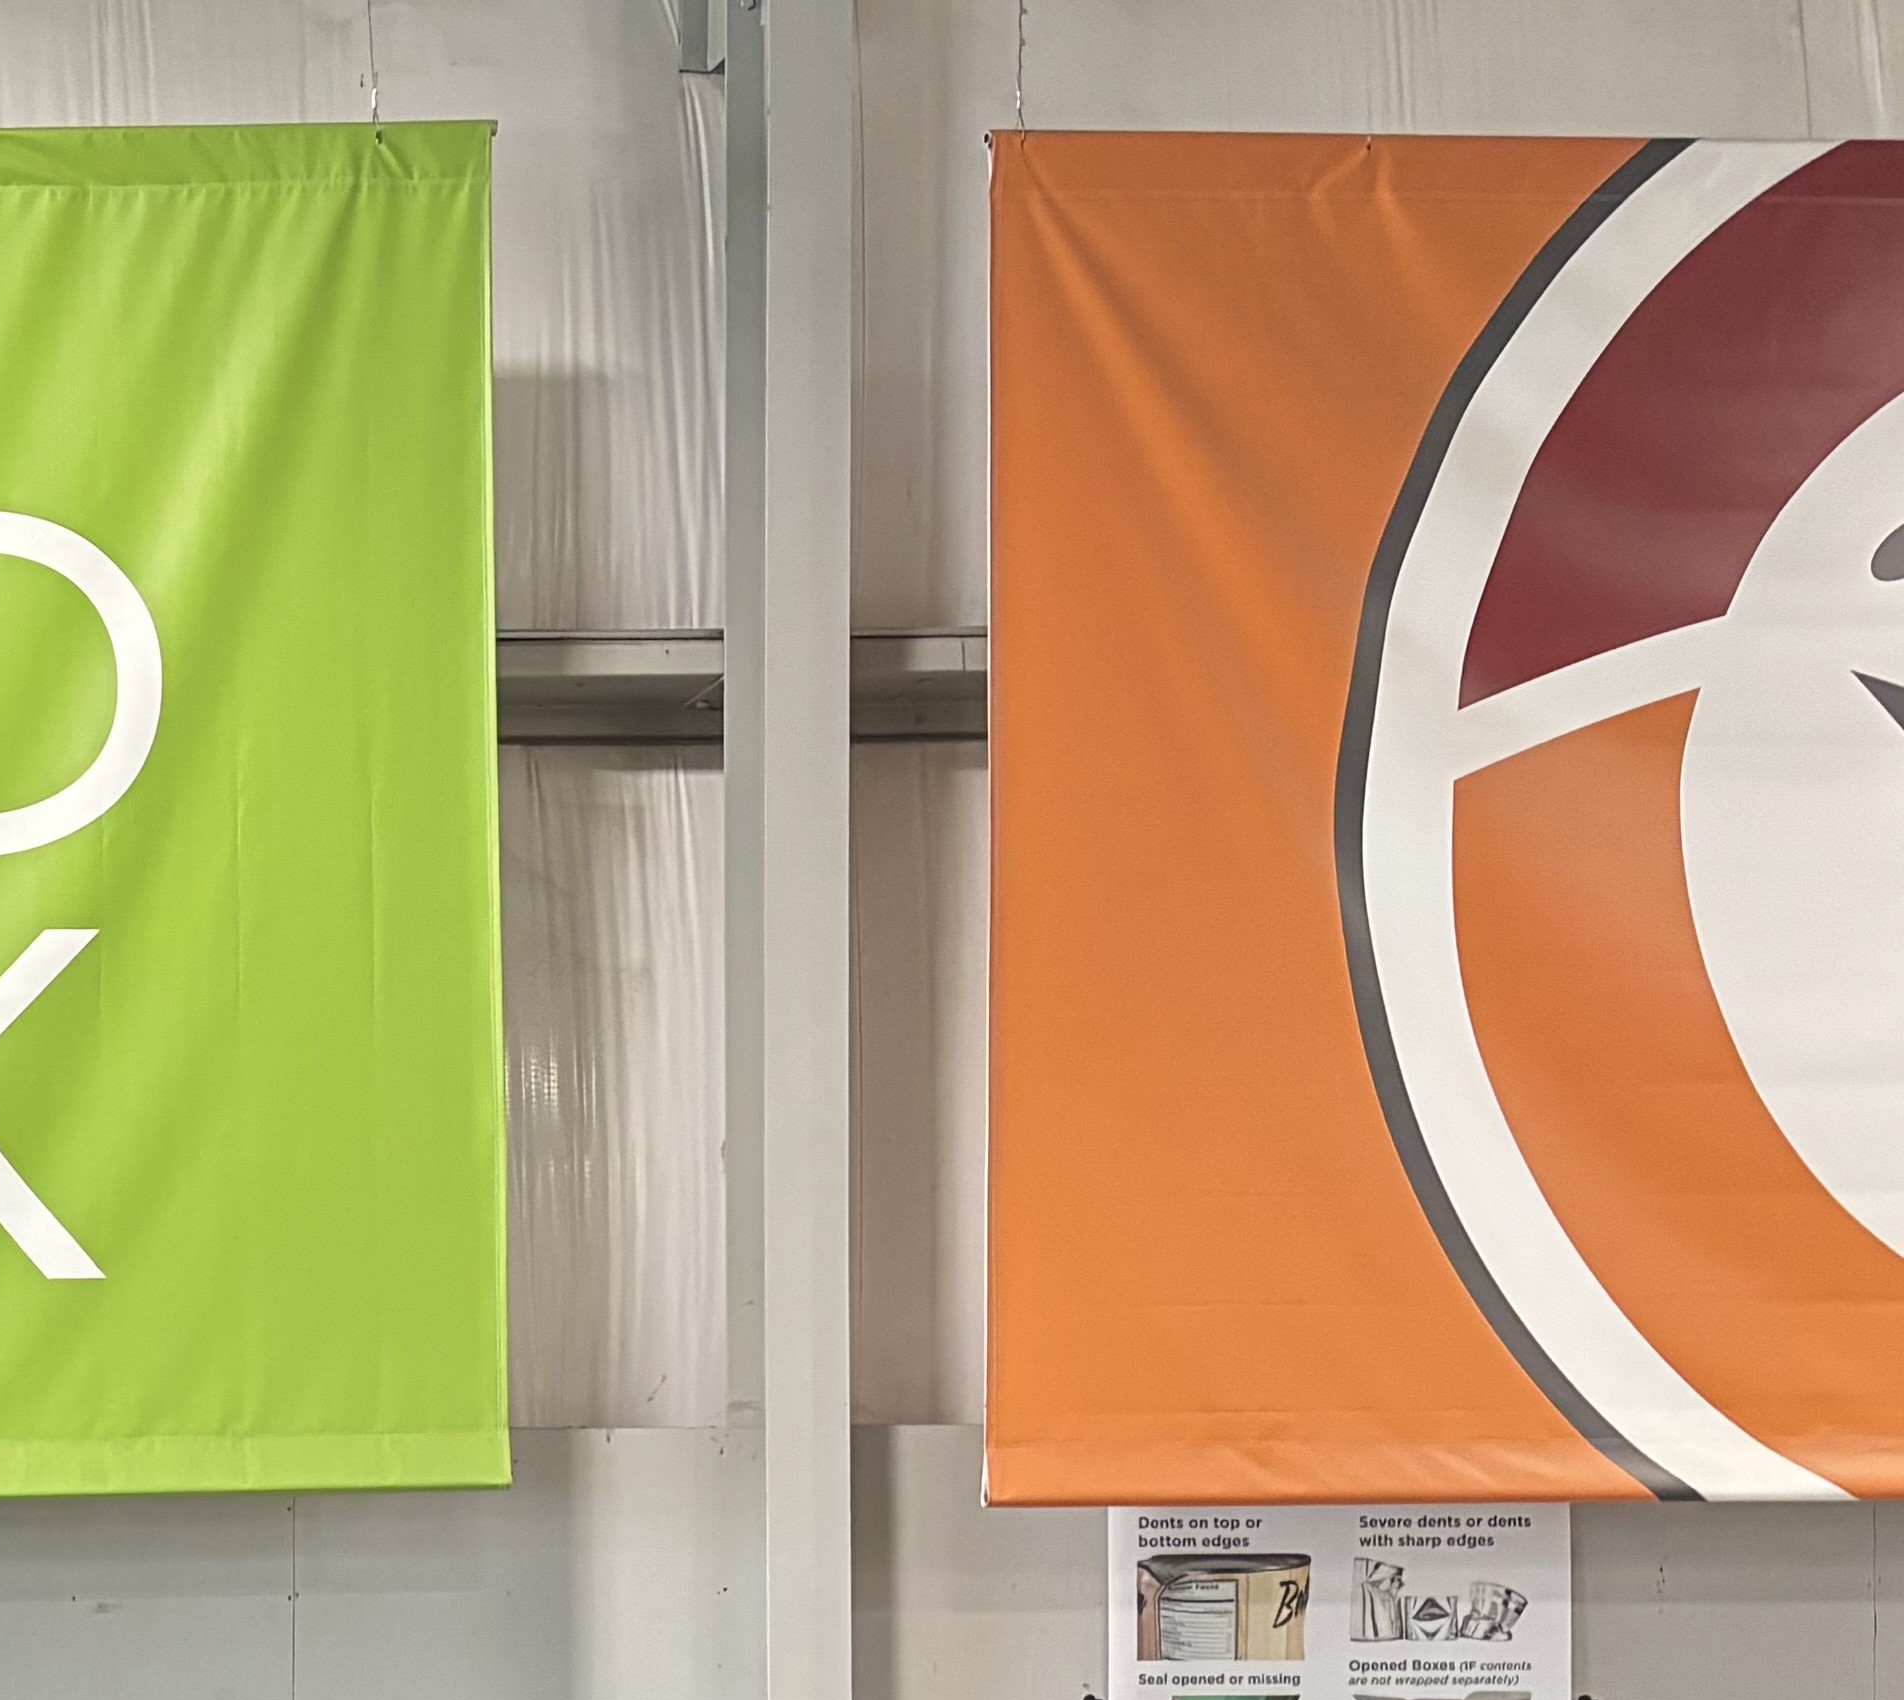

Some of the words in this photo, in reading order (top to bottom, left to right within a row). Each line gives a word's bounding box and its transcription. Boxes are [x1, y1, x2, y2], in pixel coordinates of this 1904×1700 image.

[1138, 1517, 1184, 1529] Dents
[1189, 1519, 1208, 1529] on
[1213, 1518, 1240, 1532] top
[1246, 1519, 1262, 1529] or
[1359, 1516, 1412, 1529] Severe
[1417, 1516, 1461, 1529] dents
[1465, 1518, 1483, 1529] or
[1487, 1515, 1531, 1529] dents
[1138, 1535, 1197, 1548] bottom
[1202, 1535, 1250, 1551] edges
[1359, 1534, 1393, 1548] with
[1398, 1534, 1441, 1551] sharp
[1447, 1534, 1494, 1551] edges
[1349, 1659, 1408, 1675] Opened
[1411, 1659, 1456, 1673] Boxes
[1480, 1661, 1531, 1672] contents
[1138, 1673, 1166, 1686] Seal
[1171, 1673, 1225, 1689] opened
[1228, 1676, 1244, 1686] or
[1248, 1673, 1301, 1689] missing
[1349, 1677, 1369, 1686] are
[1373, 1675, 1391, 1686] not
[1395, 1674, 1448, 1688] wrapped
[1452, 1673, 1519, 1688] separately)
